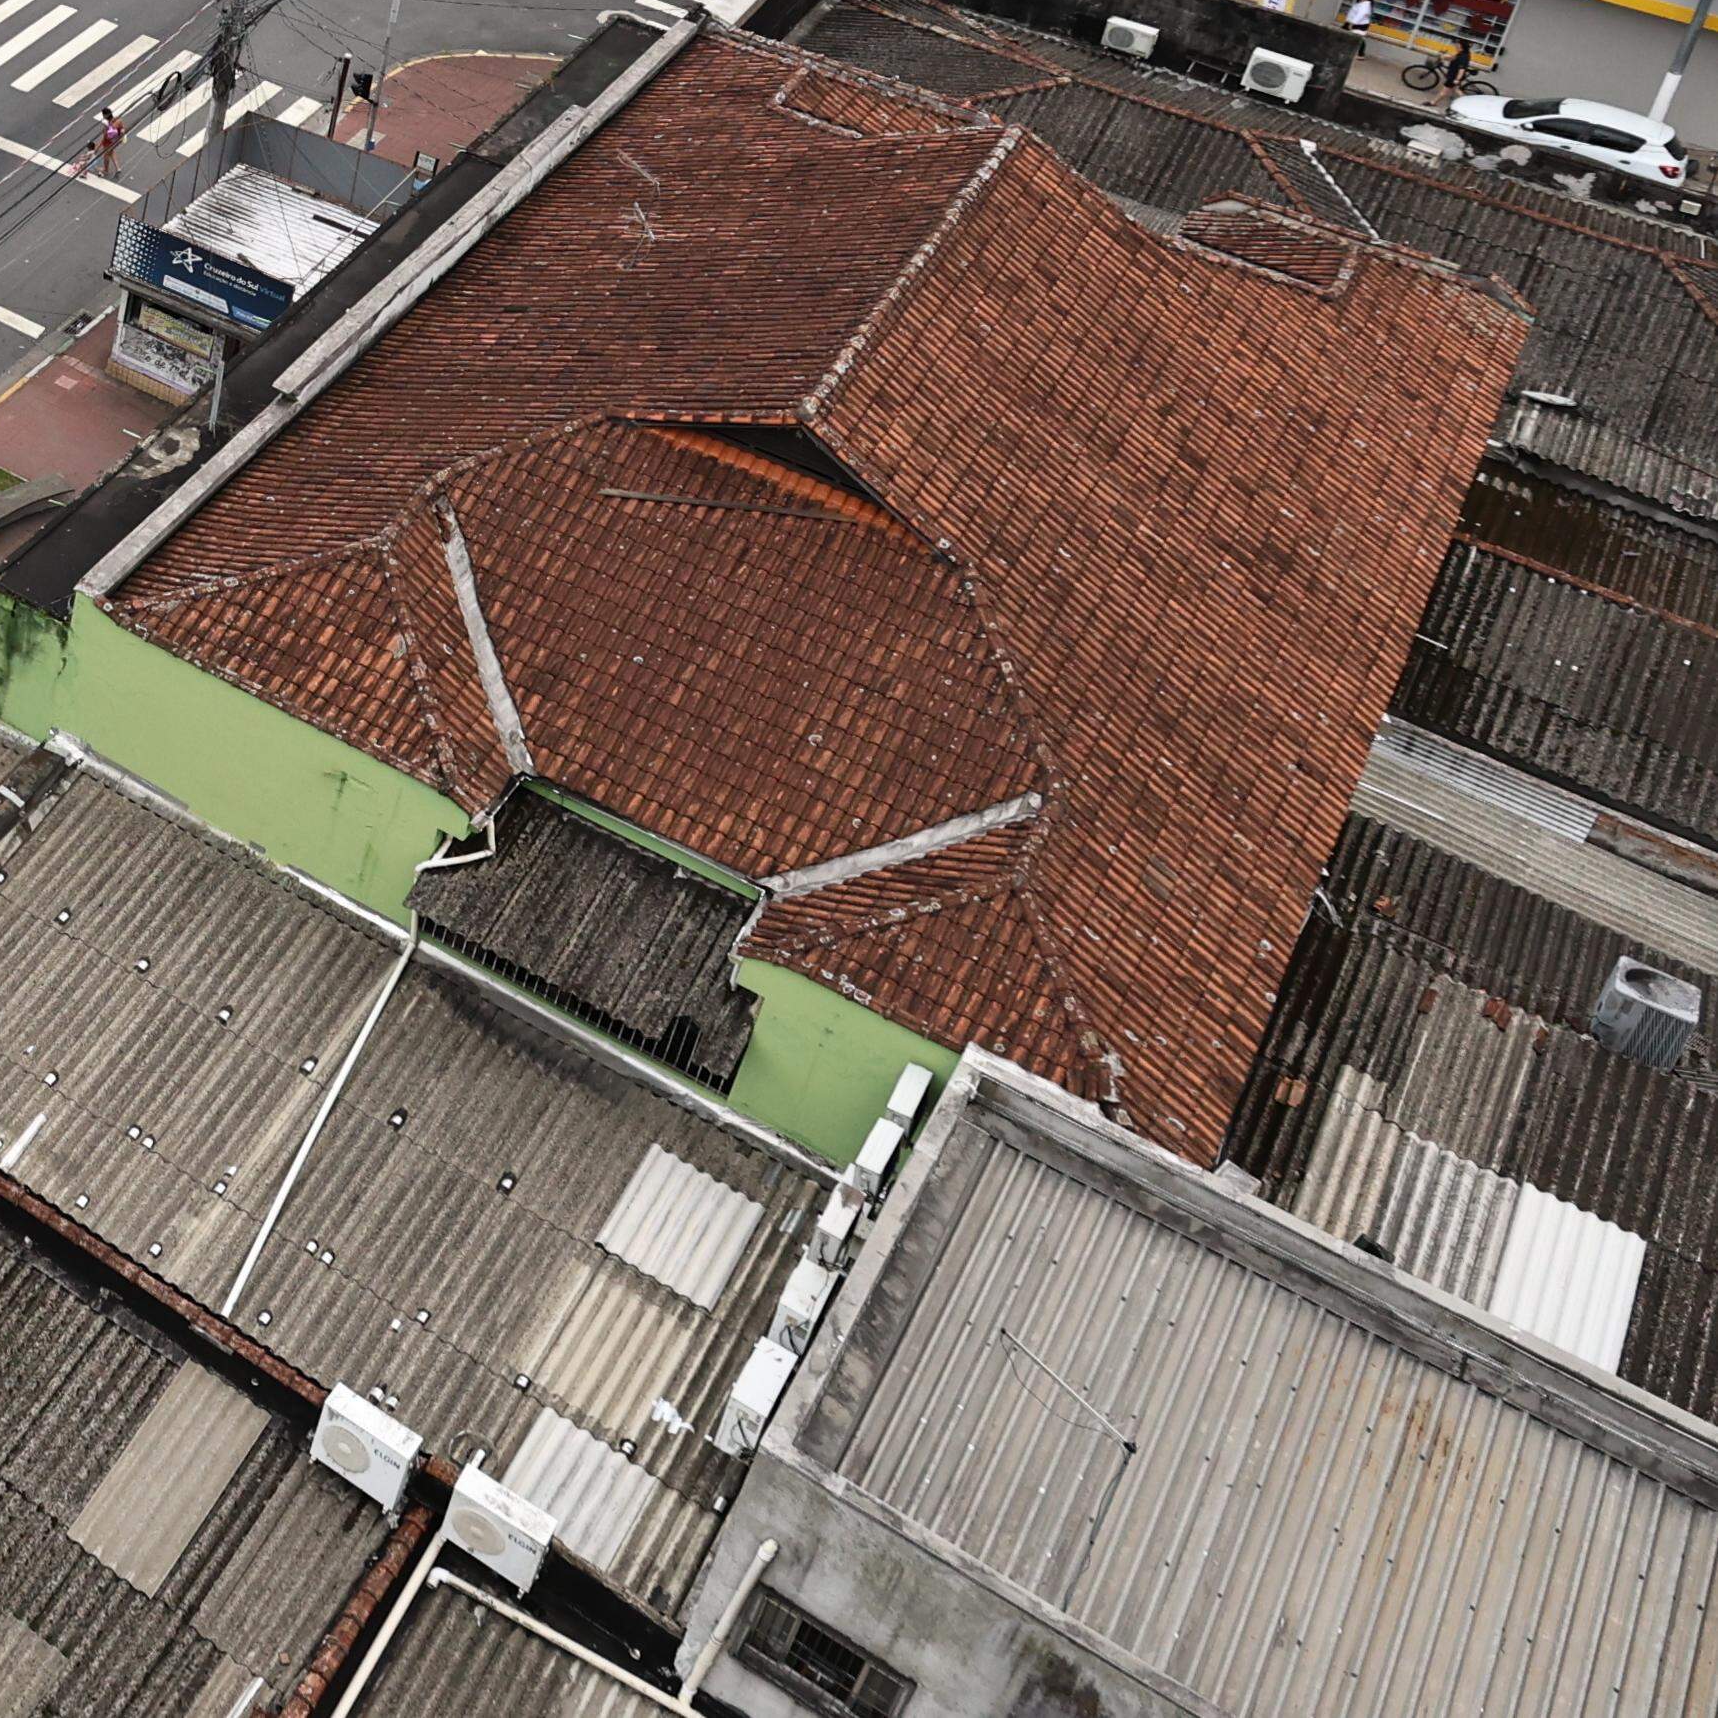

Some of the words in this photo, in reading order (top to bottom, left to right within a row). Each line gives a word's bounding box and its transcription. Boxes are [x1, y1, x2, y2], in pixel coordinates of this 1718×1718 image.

[203, 262, 236, 281] Cruzeiro
[236, 277, 246, 286] do
[247, 280, 259, 291] Sul
